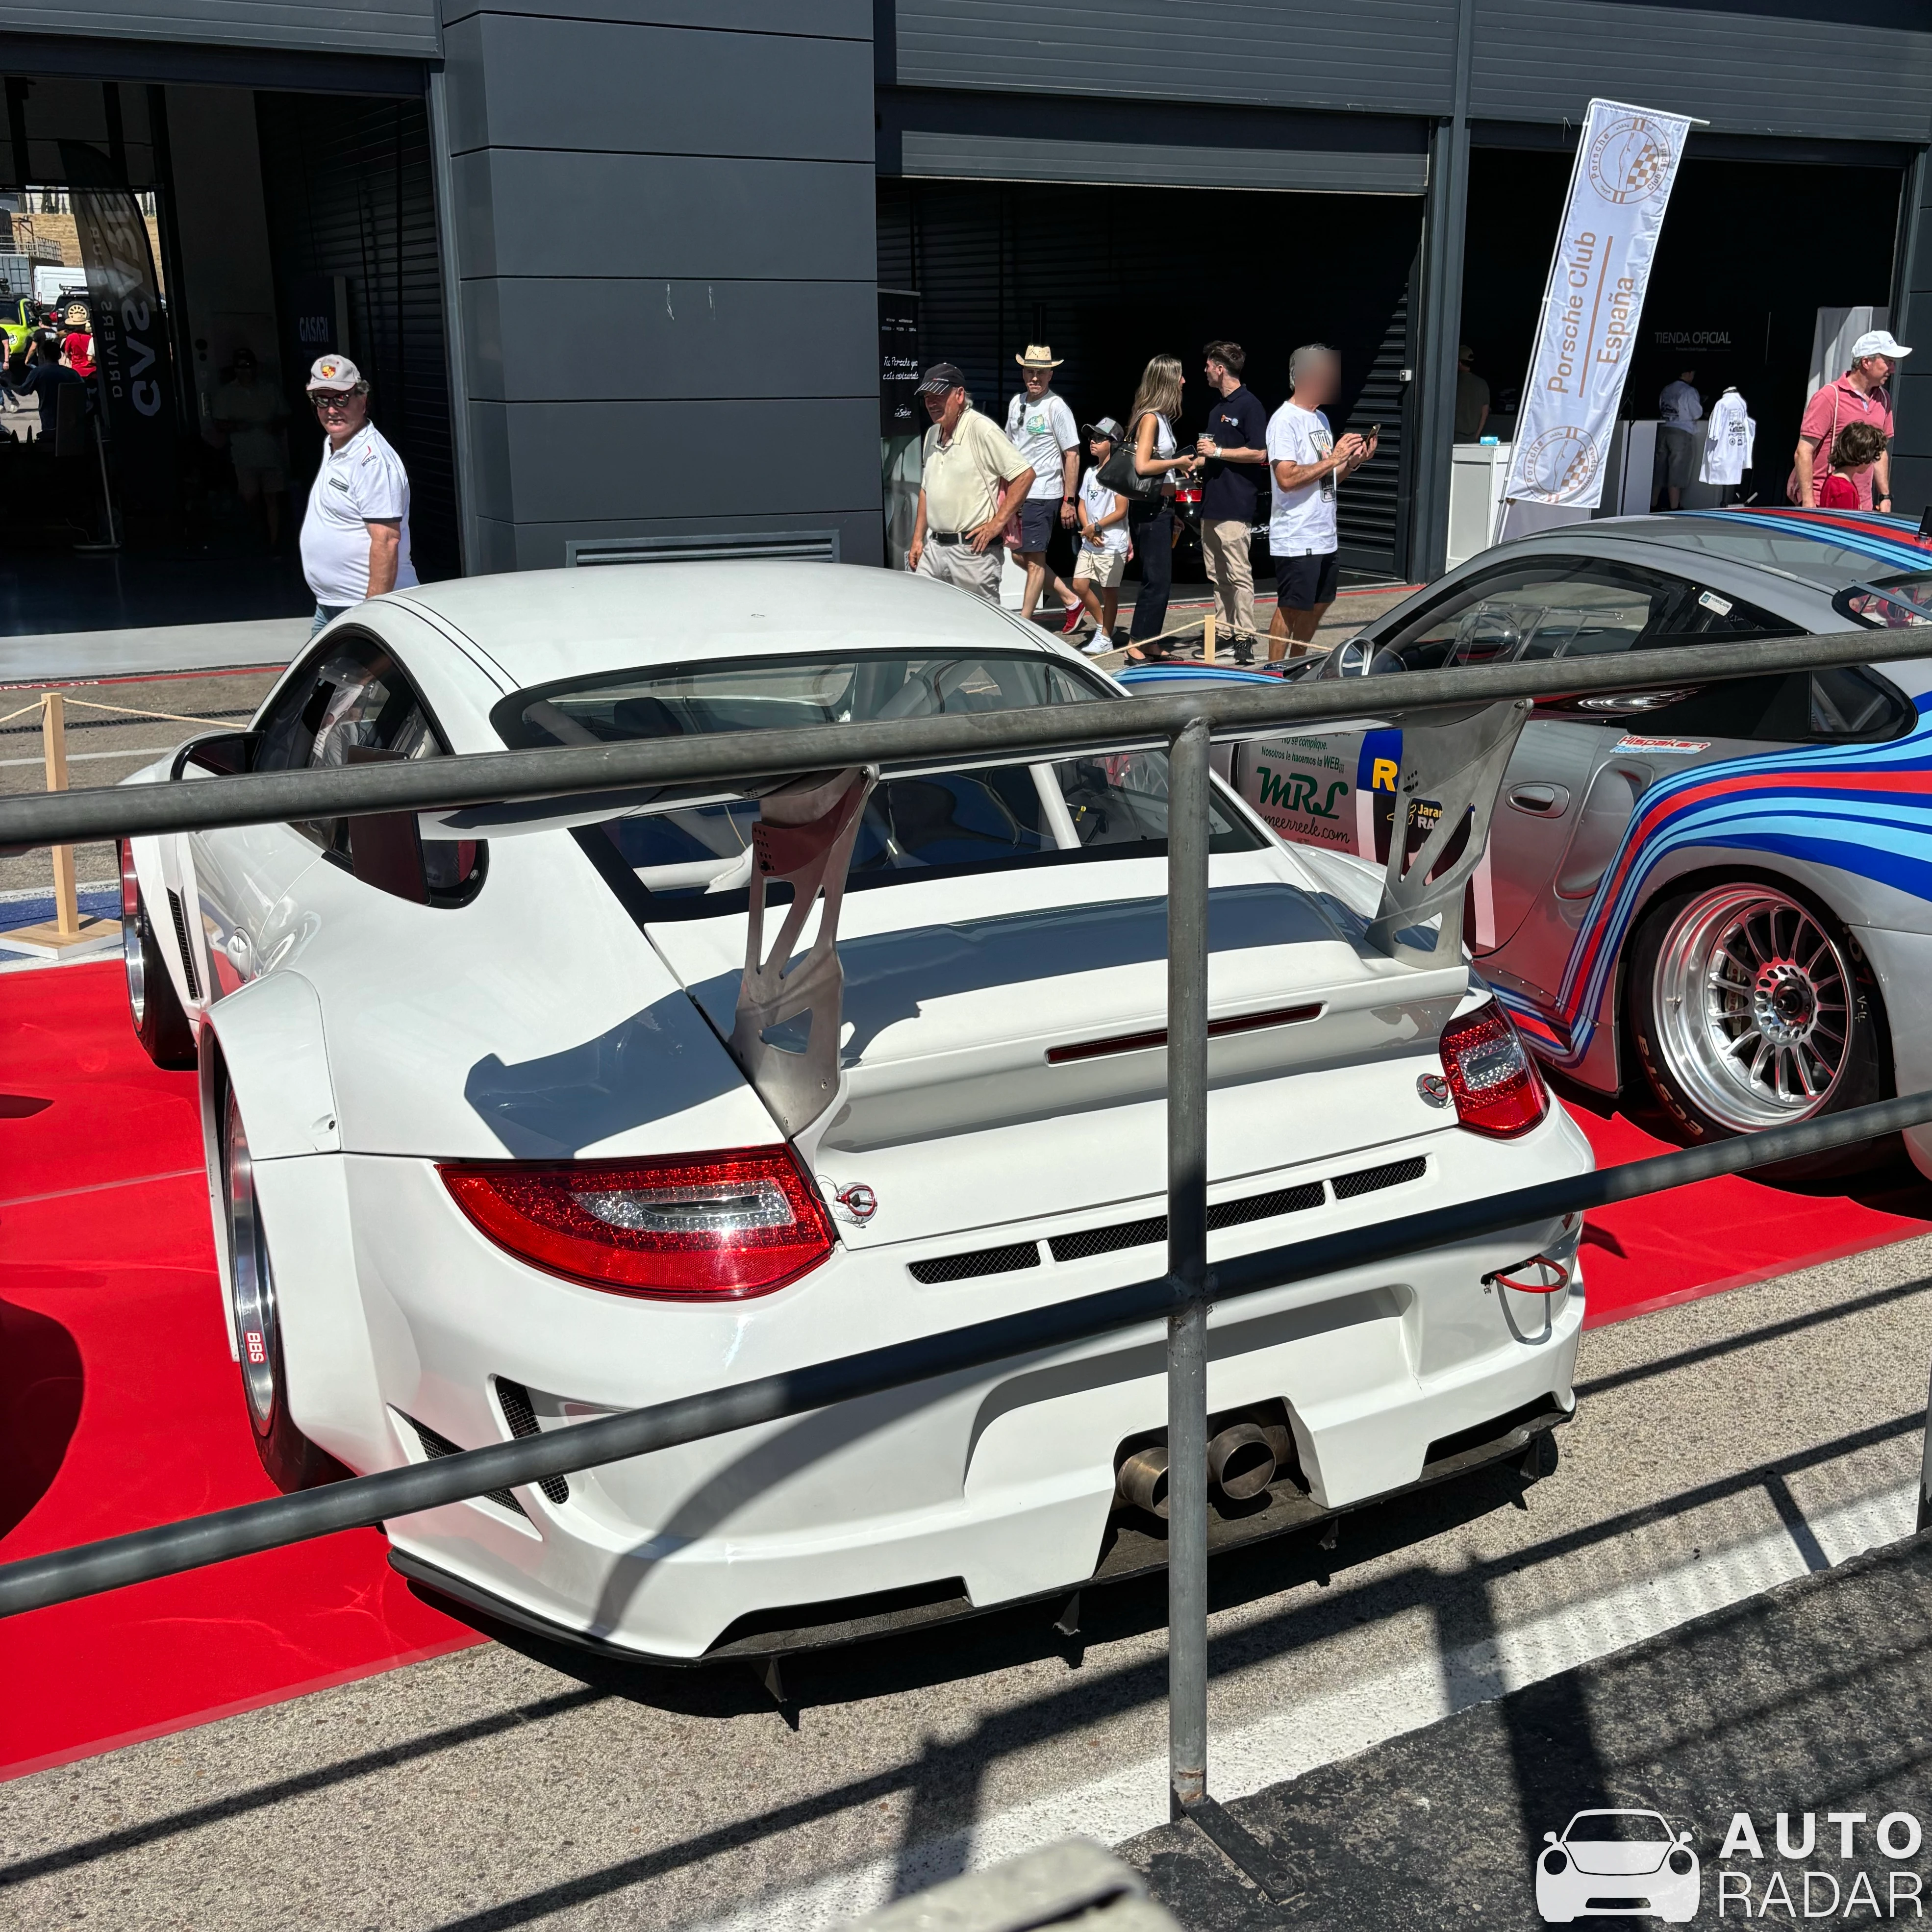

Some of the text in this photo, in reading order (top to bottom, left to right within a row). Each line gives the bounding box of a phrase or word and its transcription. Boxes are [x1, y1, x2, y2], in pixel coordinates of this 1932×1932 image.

[1591, 133, 1609, 179] Porsche
[1647, 175, 1661, 191] Club
[1547, 231, 1596, 393] Porsche Club
[1596, 277, 1634, 364] España
[1655, 331, 1731, 344] TIENDA OFICIAL
[1527, 441, 1543, 483] Porsche
[1261, 746, 1284, 759] Nosotros
[1292, 753, 1316, 766] hacemos
[1317, 757, 1322, 767] la
[247, 1332, 264, 1362] BBS
